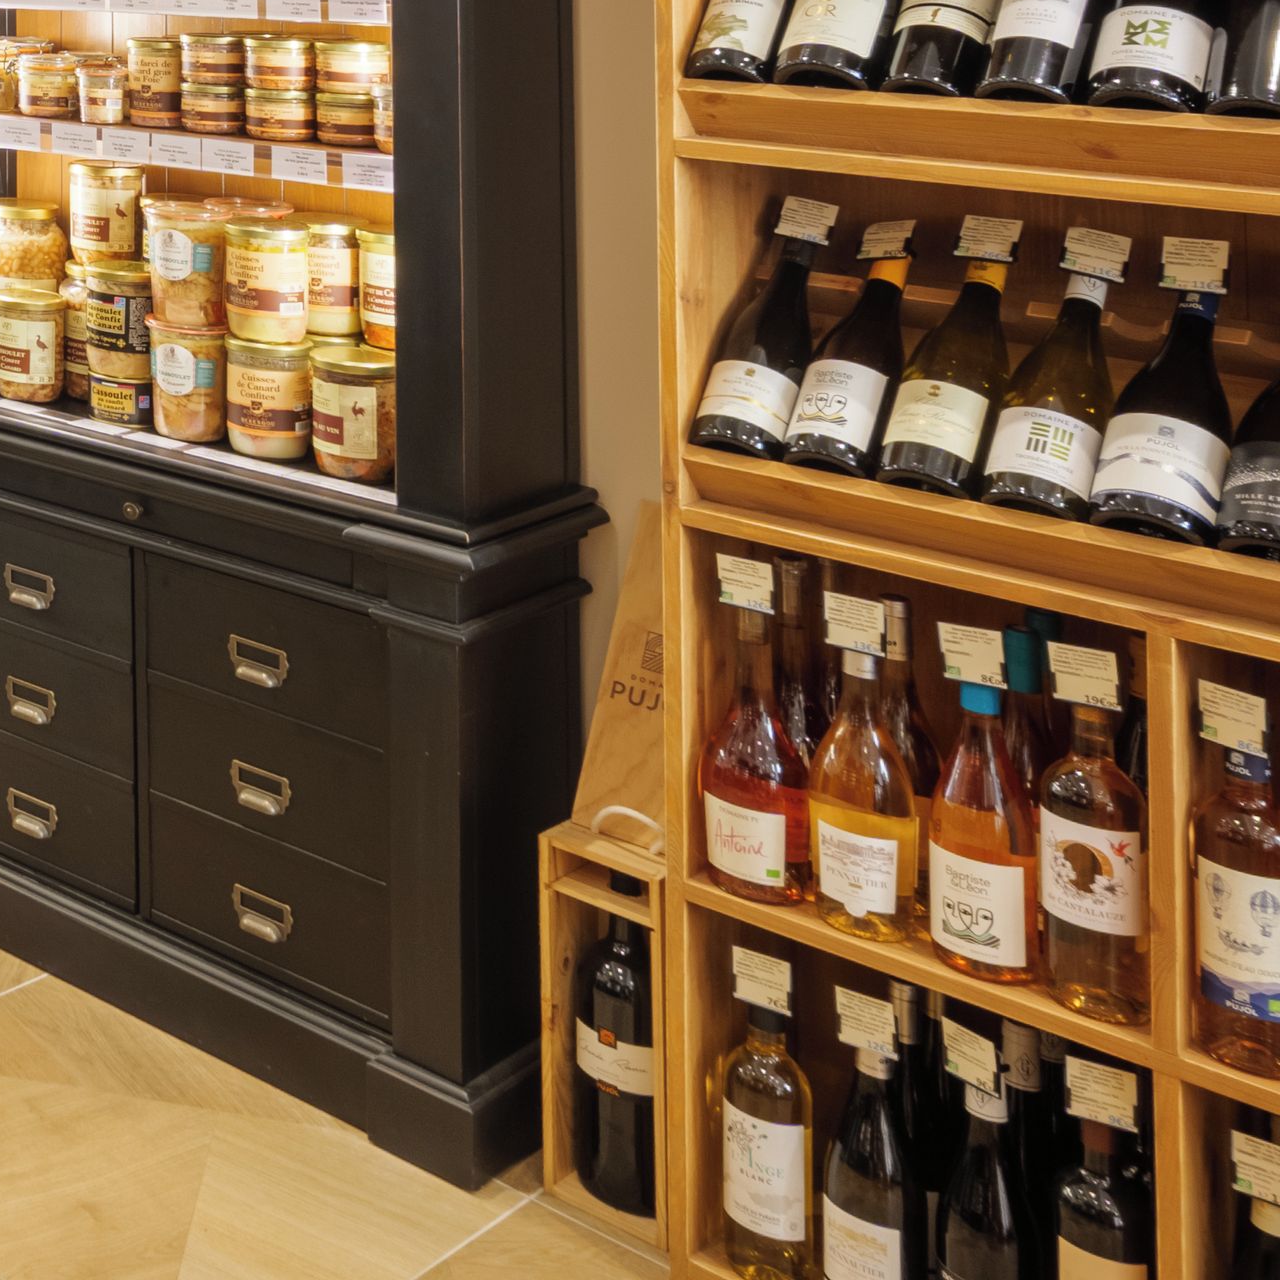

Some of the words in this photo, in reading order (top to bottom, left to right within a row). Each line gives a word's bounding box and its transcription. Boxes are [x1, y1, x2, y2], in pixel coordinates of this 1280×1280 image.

[1120, 9, 1166, 18] DOMAINE
[140, 59, 158, 67] farci
[230, 252, 260, 263] Cuisses
[235, 261, 264, 272] Canard
[230, 271, 260, 281] Confites
[87, 305, 122, 316] Cassoulet
[95, 312, 121, 323] Confit
[92, 320, 124, 331] Canard
[241, 372, 277, 384] Cuisses
[247, 382, 281, 393] Canard
[92, 387, 133, 401] Cassoulet
[240, 389, 276, 401] Confites
[1024, 411, 1069, 426] DOMAINE
[326, 424, 340, 434] VIN
[1146, 437, 1181, 451] PUJOL
[631, 674, 663, 689] DOMA
[609, 681, 662, 712] PUJ
[713, 818, 768, 858] Antoine
[826, 864, 888, 890] PENNAUTIER
[945, 864, 991, 888] Baptiste
[1058, 896, 1127, 921] CANTALAUZE
[1225, 999, 1258, 1017] PUJOL
[739, 1167, 773, 1187] BLANC
